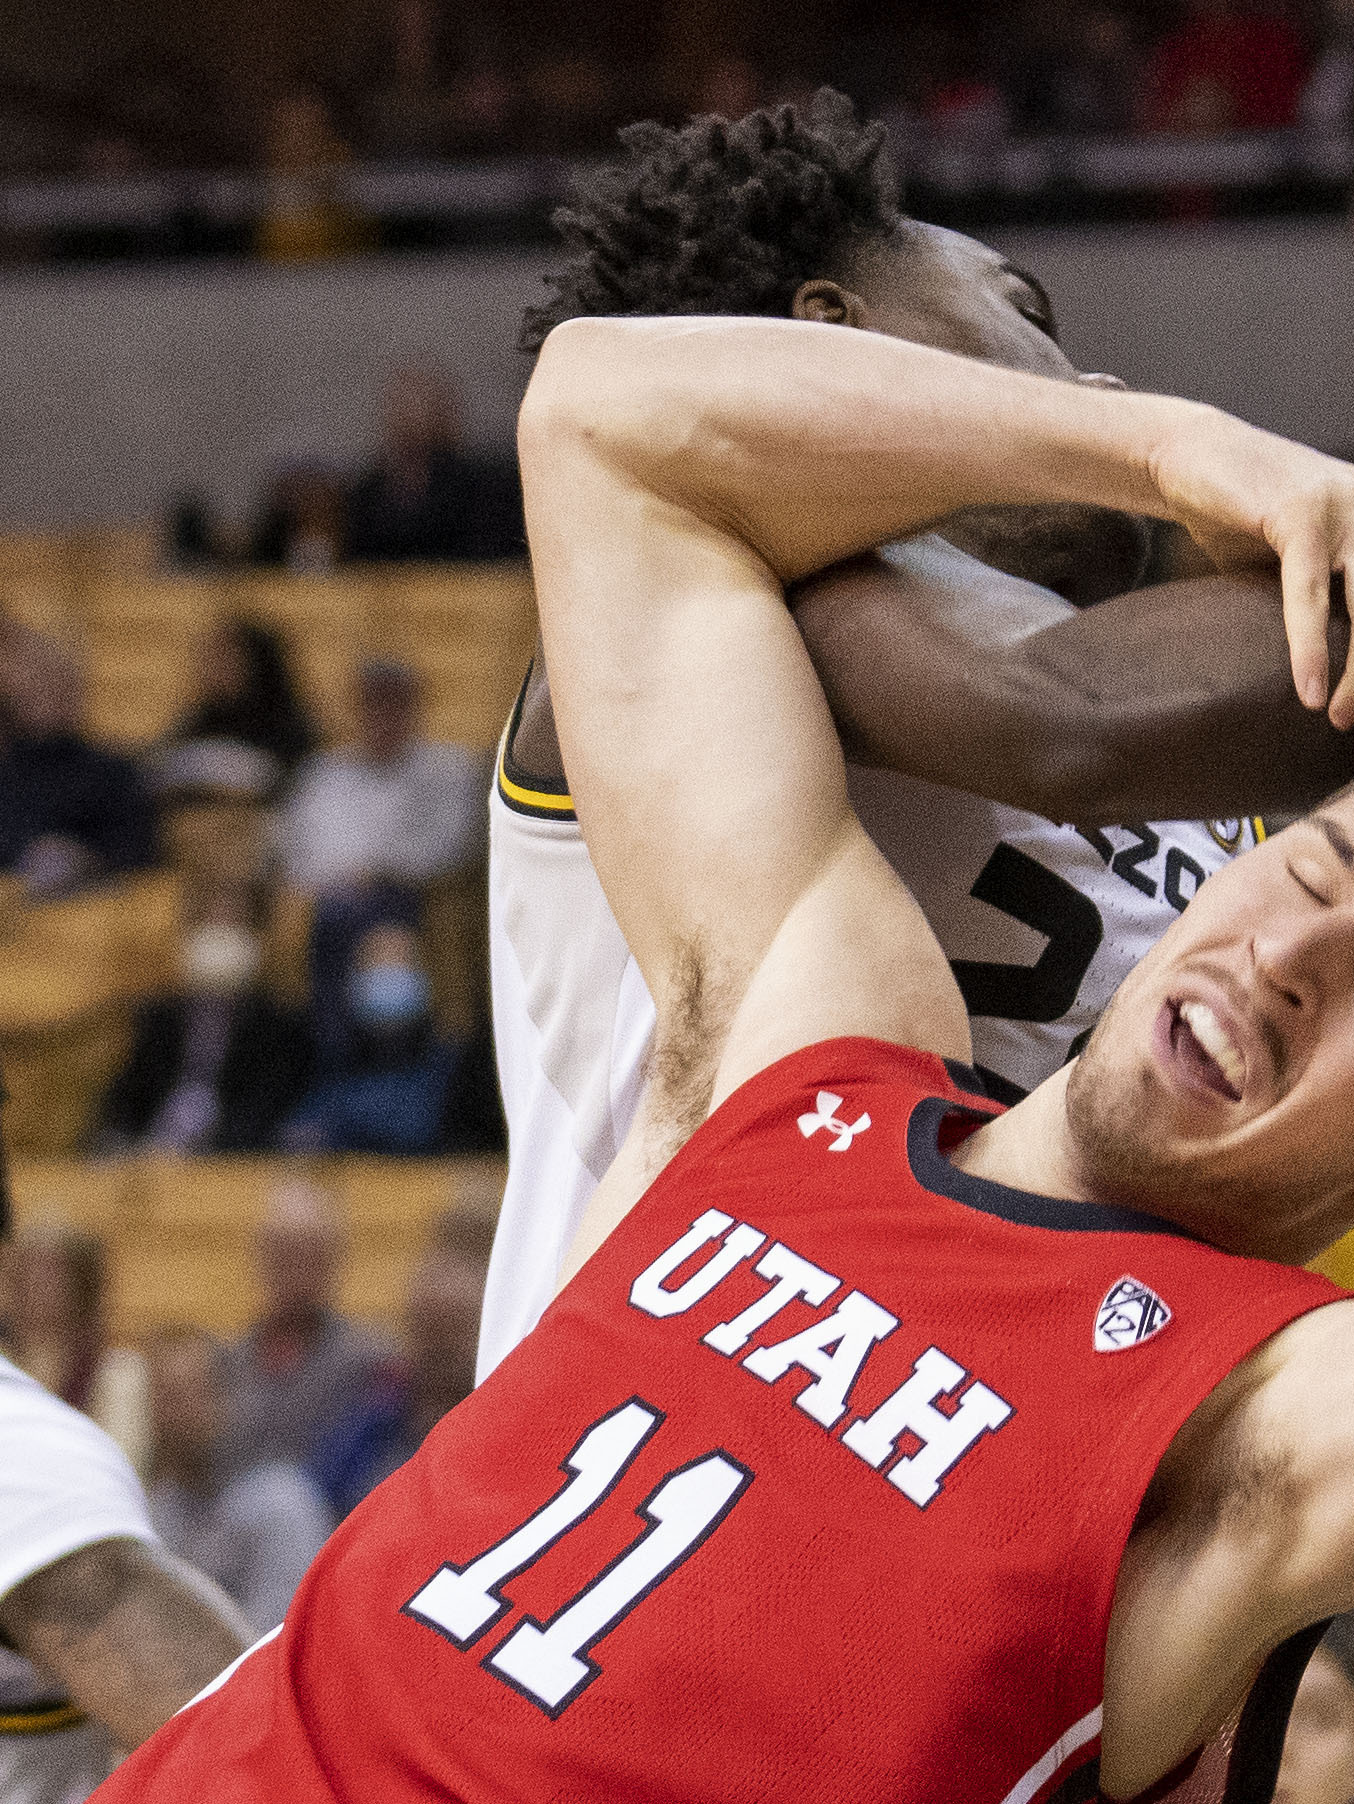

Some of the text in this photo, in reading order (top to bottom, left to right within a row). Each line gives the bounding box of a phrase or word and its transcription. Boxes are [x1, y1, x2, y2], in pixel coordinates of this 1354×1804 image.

[628, 1207, 1016, 1510] UTAH
[1099, 1310, 1136, 1346] 12
[1102, 1281, 1168, 1340] PAC
[400, 1396, 756, 1721] 11
